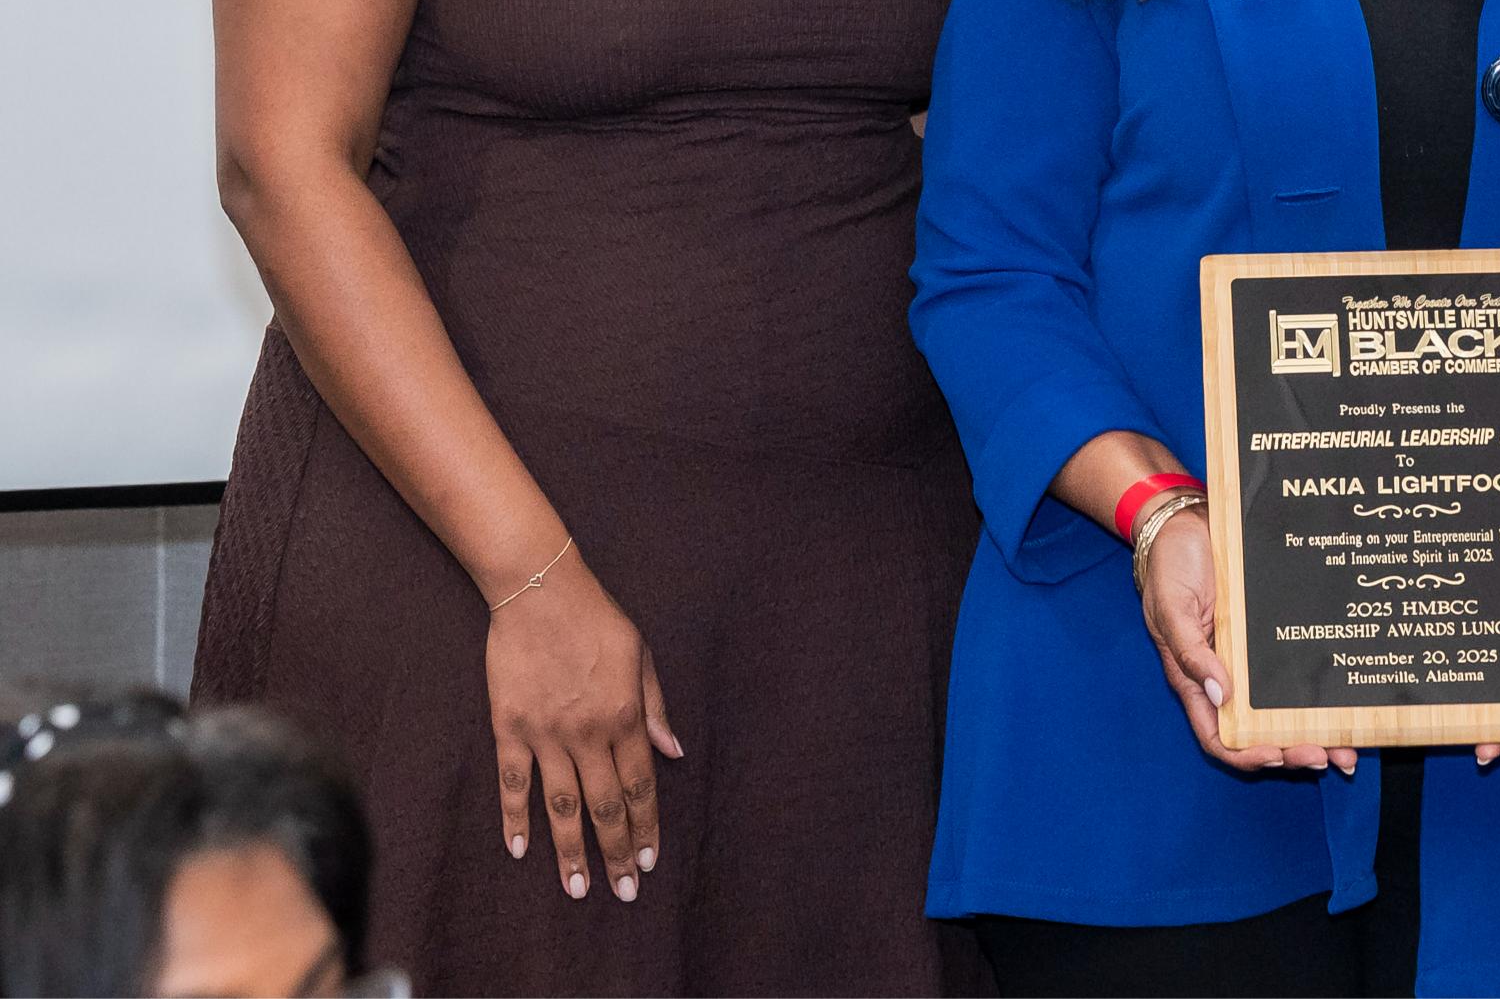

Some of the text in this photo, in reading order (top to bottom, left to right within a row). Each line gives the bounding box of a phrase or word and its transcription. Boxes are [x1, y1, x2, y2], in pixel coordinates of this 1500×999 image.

[1341, 295, 1389, 313] Together
[1391, 294, 1412, 309] We
[1413, 294, 1453, 311] Create
[1454, 293, 1478, 308] Our
[1348, 310, 1457, 332] HUNTSVILLE
[1349, 359, 1420, 377] CHAMBER
[1421, 359, 1442, 375] OF
[1339, 401, 1466, 418] Proudly Presents the
[1250, 429, 1395, 451] ENTREPRENEURIAL
[1400, 427, 1495, 447] LEADERSHIP
[1394, 453, 1415, 468] To
[1282, 476, 1366, 498] NAKIA
[1285, 533, 1305, 547] For
[1307, 531, 1363, 550] expanding
[1366, 533, 1381, 545] on
[1384, 533, 1409, 548] your
[1412, 528, 1494, 547] Entrepreneurial
[1325, 547, 1495, 566] and Innovative Spirit in 2025.
[1345, 599, 1479, 618] 2025 HMBCC
[1275, 623, 1381, 641] MEMBERSHIP
[1386, 621, 1456, 638] AWARDS
[1332, 648, 1498, 667] November 20, 2025
[1347, 668, 1485, 685] Huntsville, Alabama
